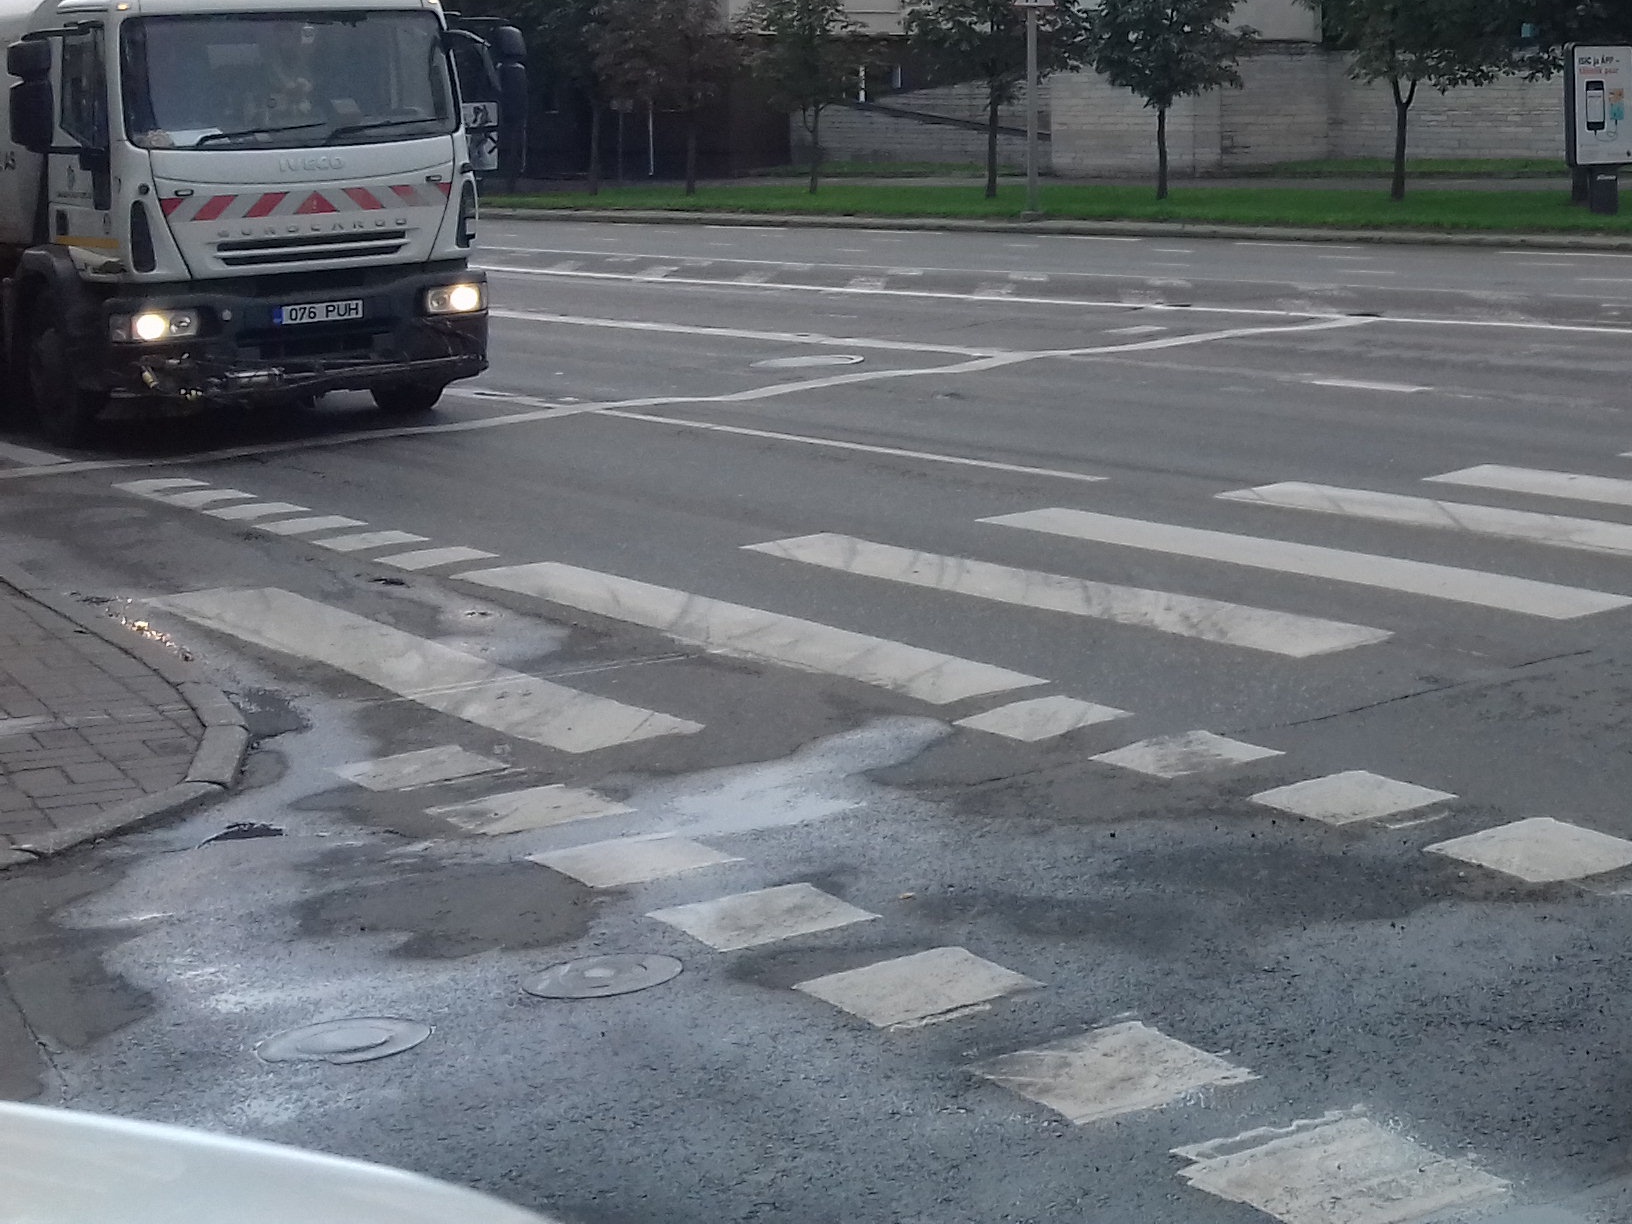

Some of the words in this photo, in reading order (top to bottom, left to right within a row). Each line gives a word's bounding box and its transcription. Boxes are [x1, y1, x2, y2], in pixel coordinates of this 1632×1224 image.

[279, 156, 346, 173] IVECO
[289, 306, 317, 322] 076
[325, 302, 359, 319] PUH
